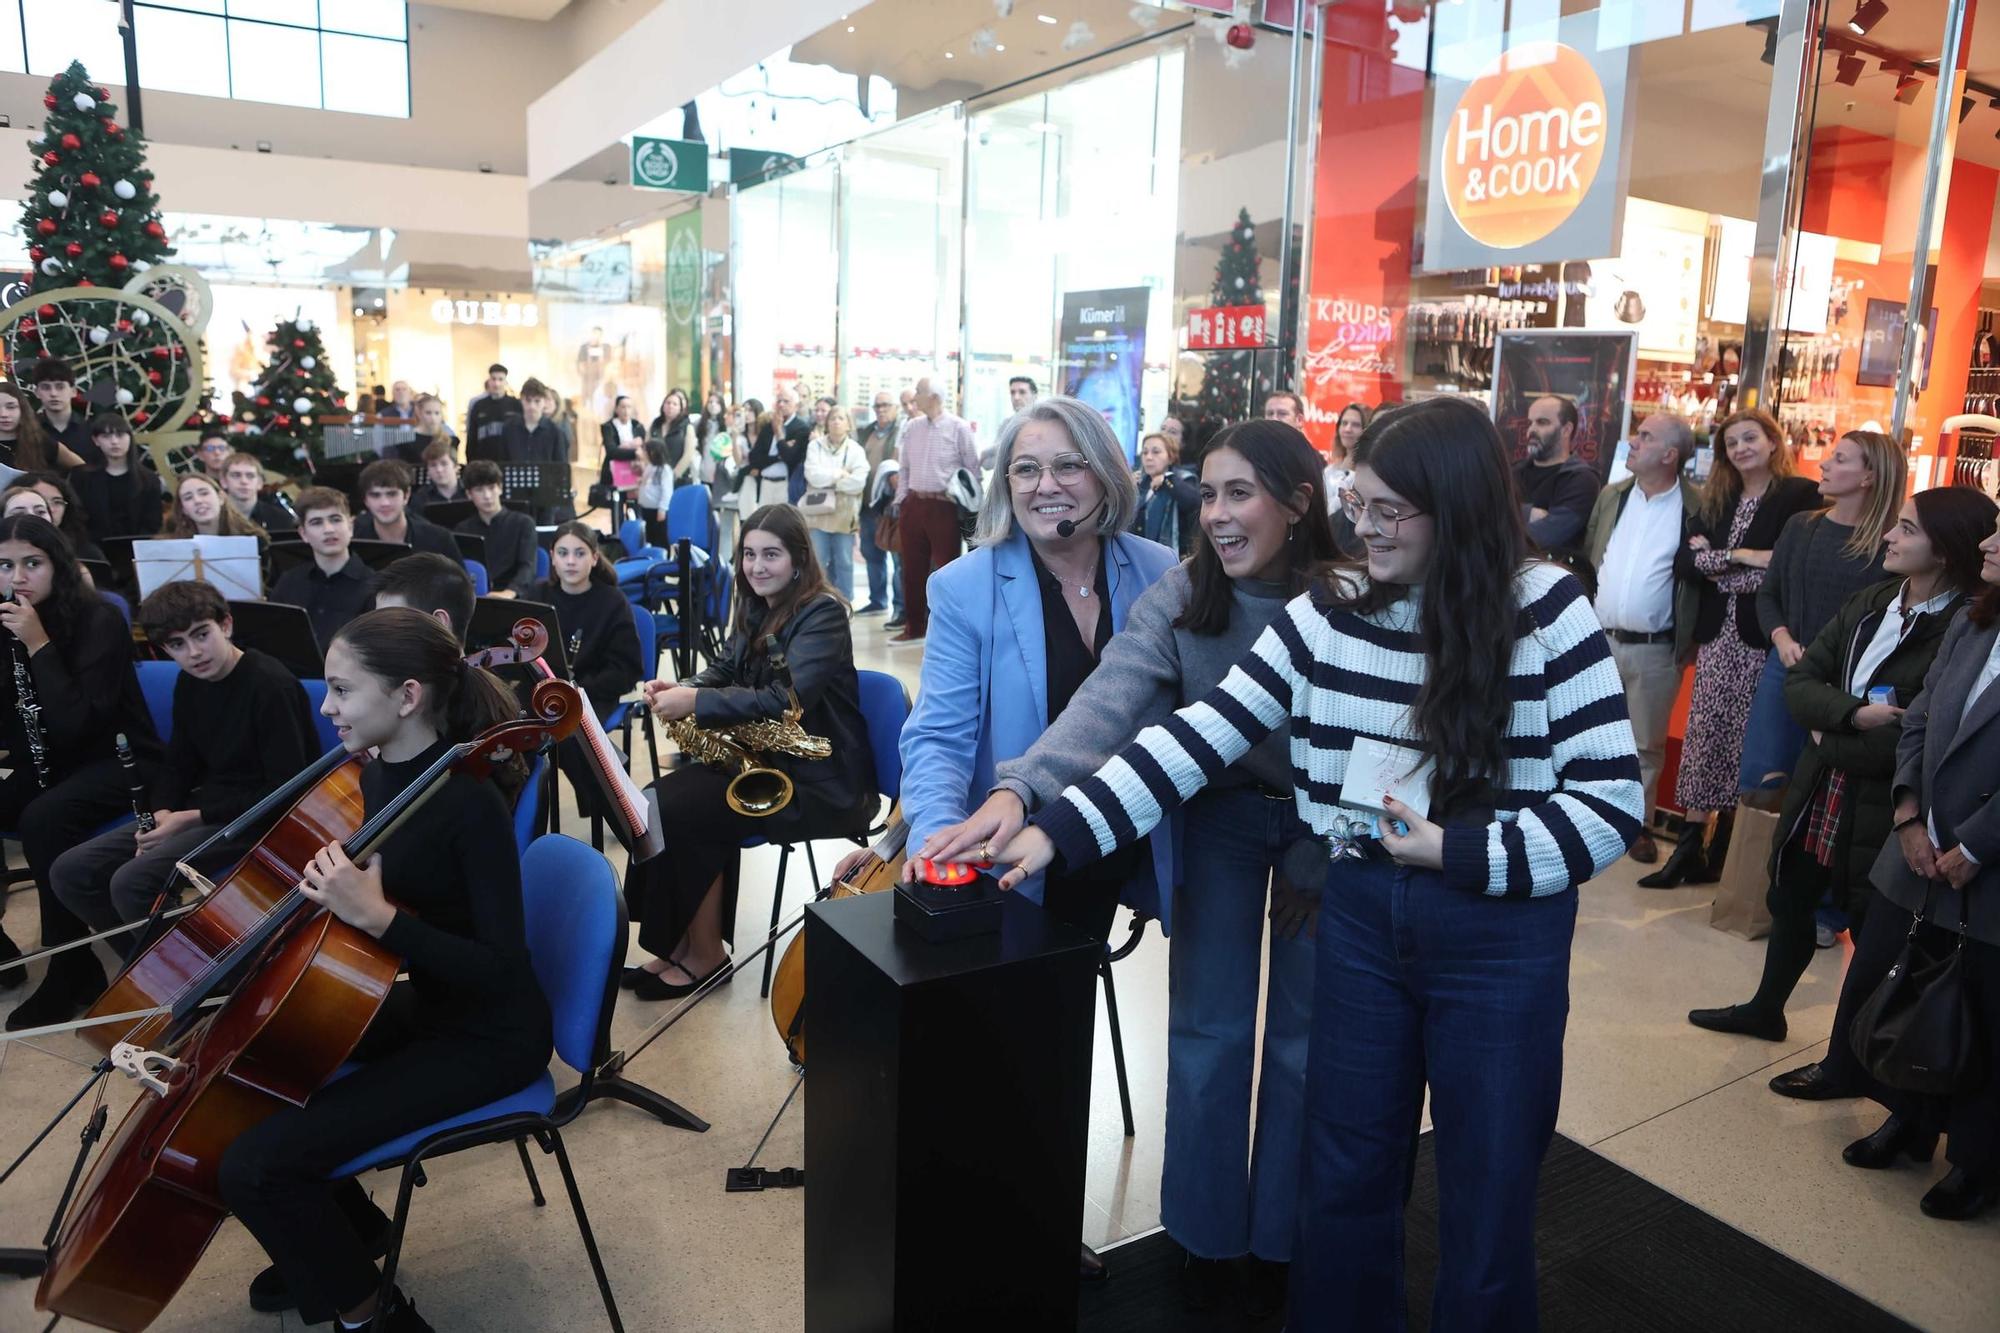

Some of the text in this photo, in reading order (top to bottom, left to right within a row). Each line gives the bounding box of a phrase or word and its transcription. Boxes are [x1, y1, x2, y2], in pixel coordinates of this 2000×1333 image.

[1456, 101, 1602, 165] Home
[1464, 152, 1583, 202] &COOK
[1317, 298, 1391, 328] KRUPS
[1305, 337, 1395, 385] Lagostina
